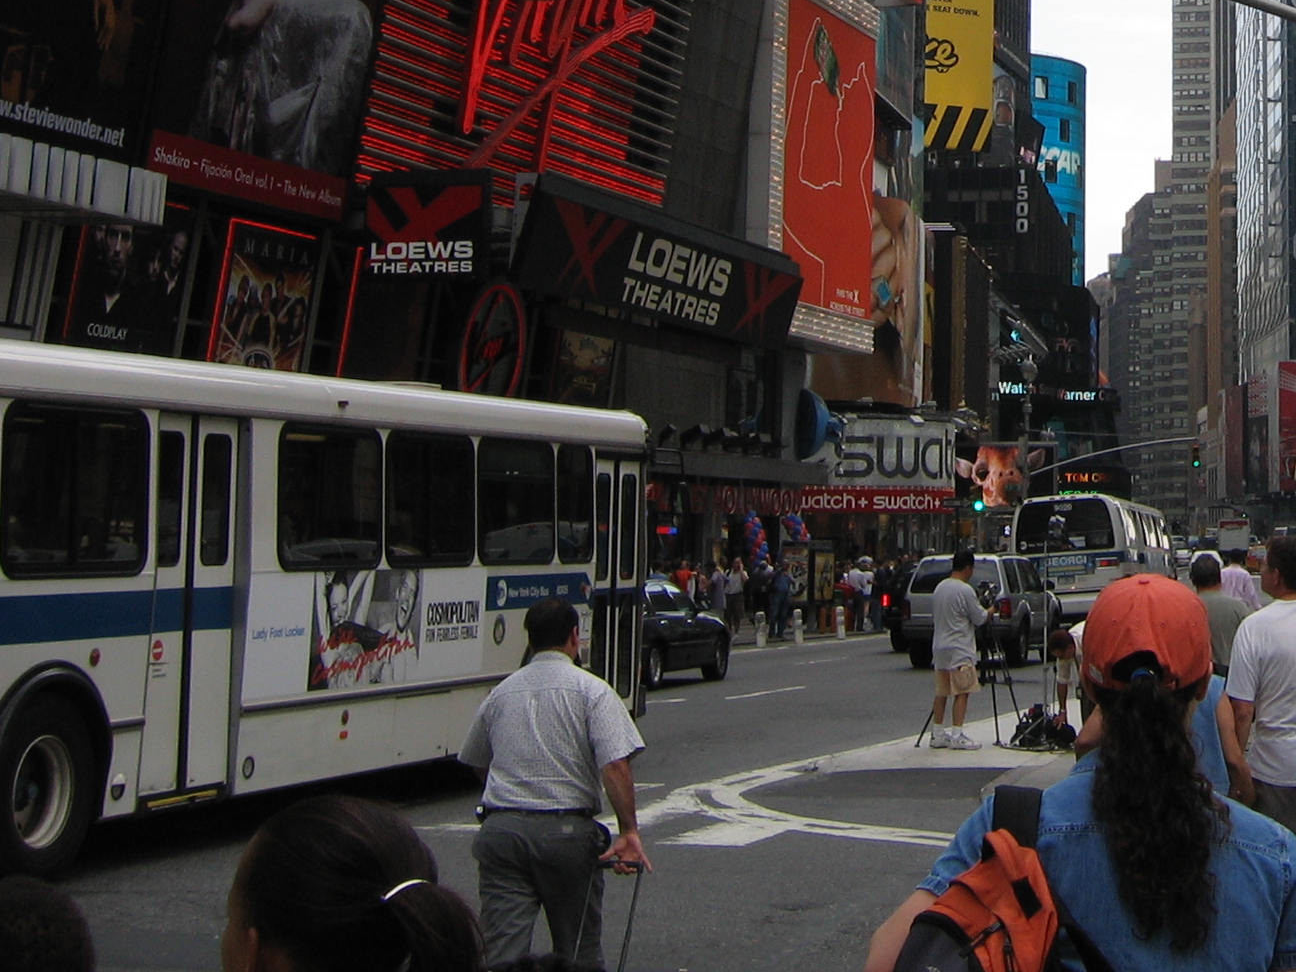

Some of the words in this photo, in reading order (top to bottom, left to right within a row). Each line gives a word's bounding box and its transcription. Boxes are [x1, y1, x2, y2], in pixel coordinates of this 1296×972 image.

[154, 147, 190, 169] Shakira
[235, 168, 253, 184] Oral
[283, 184, 297, 196] The
[298, 184, 317, 200] New
[318, 189, 342, 206] Album
[1016, 169, 1028, 233] 1500
[370, 240, 473, 260] LOEWS
[371, 260, 473, 274] THEATRES
[628, 232, 733, 296] LOEWS
[622, 277, 720, 326] THEATRES
[87, 323, 128, 340] COLDPLAY
[426, 600, 480, 627] COSMOPOLITAN
[252, 628, 267, 641] Lady
[269, 628, 283, 640] Foot
[285, 627, 305, 639] Locker
[425, 631, 435, 643] FUN
[436, 628, 458, 642] FEARLESS
[459, 625, 478, 640] FEMALE
